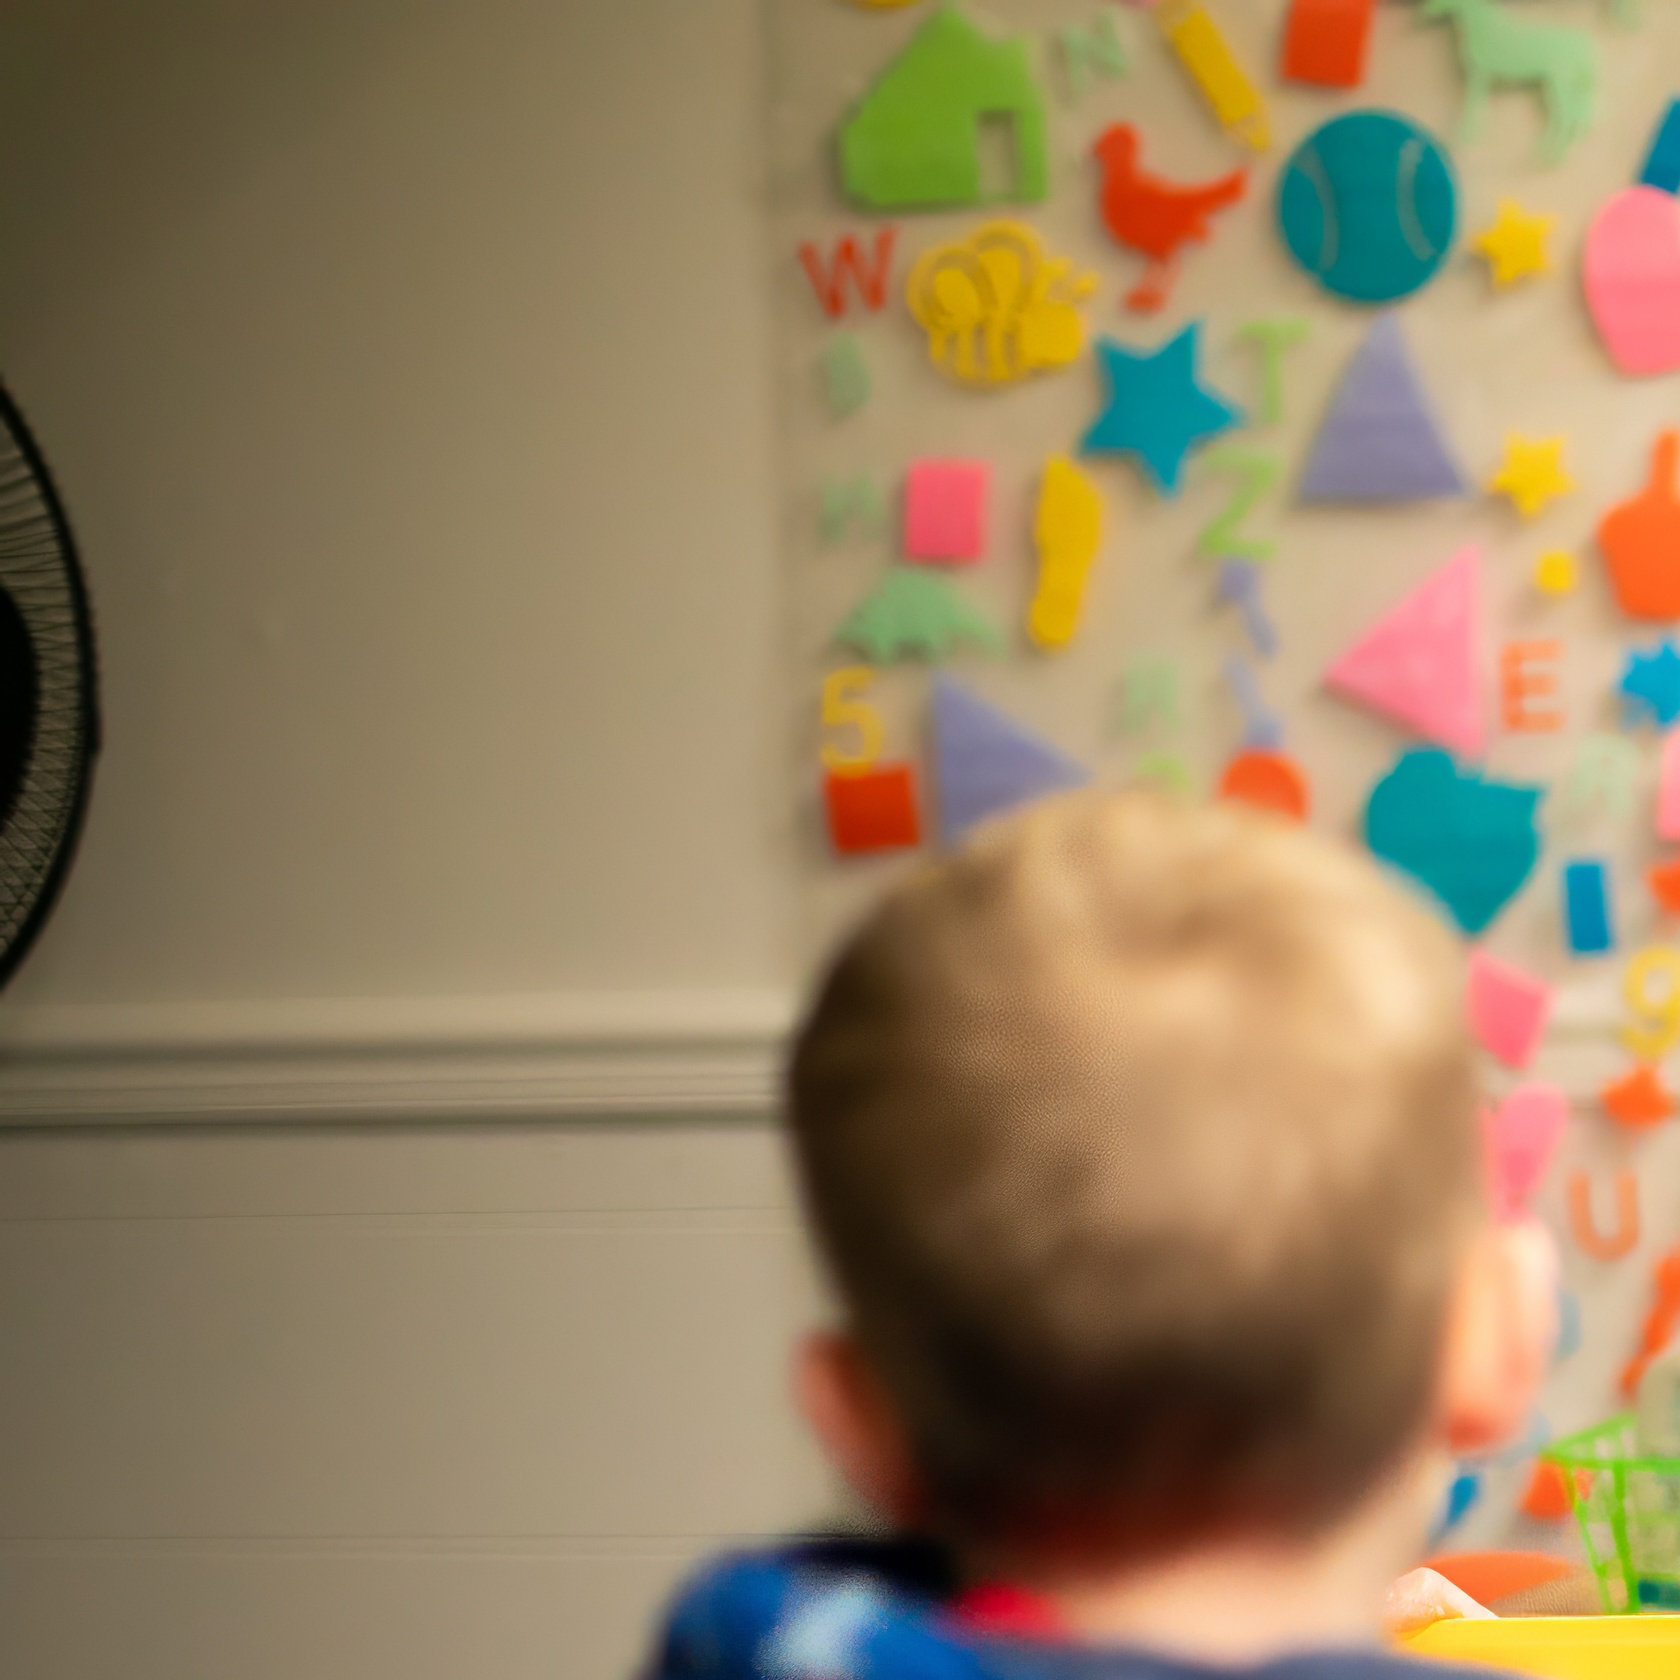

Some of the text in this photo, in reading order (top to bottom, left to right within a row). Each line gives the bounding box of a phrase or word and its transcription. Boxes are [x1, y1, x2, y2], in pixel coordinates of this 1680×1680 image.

[798, 228, 898, 321] W
[1235, 318, 1313, 428] T
[1198, 448, 1282, 562] Z
[820, 664, 887, 778] 5
[1499, 640, 1565, 735] E
[1569, 1170, 1640, 1263] U
